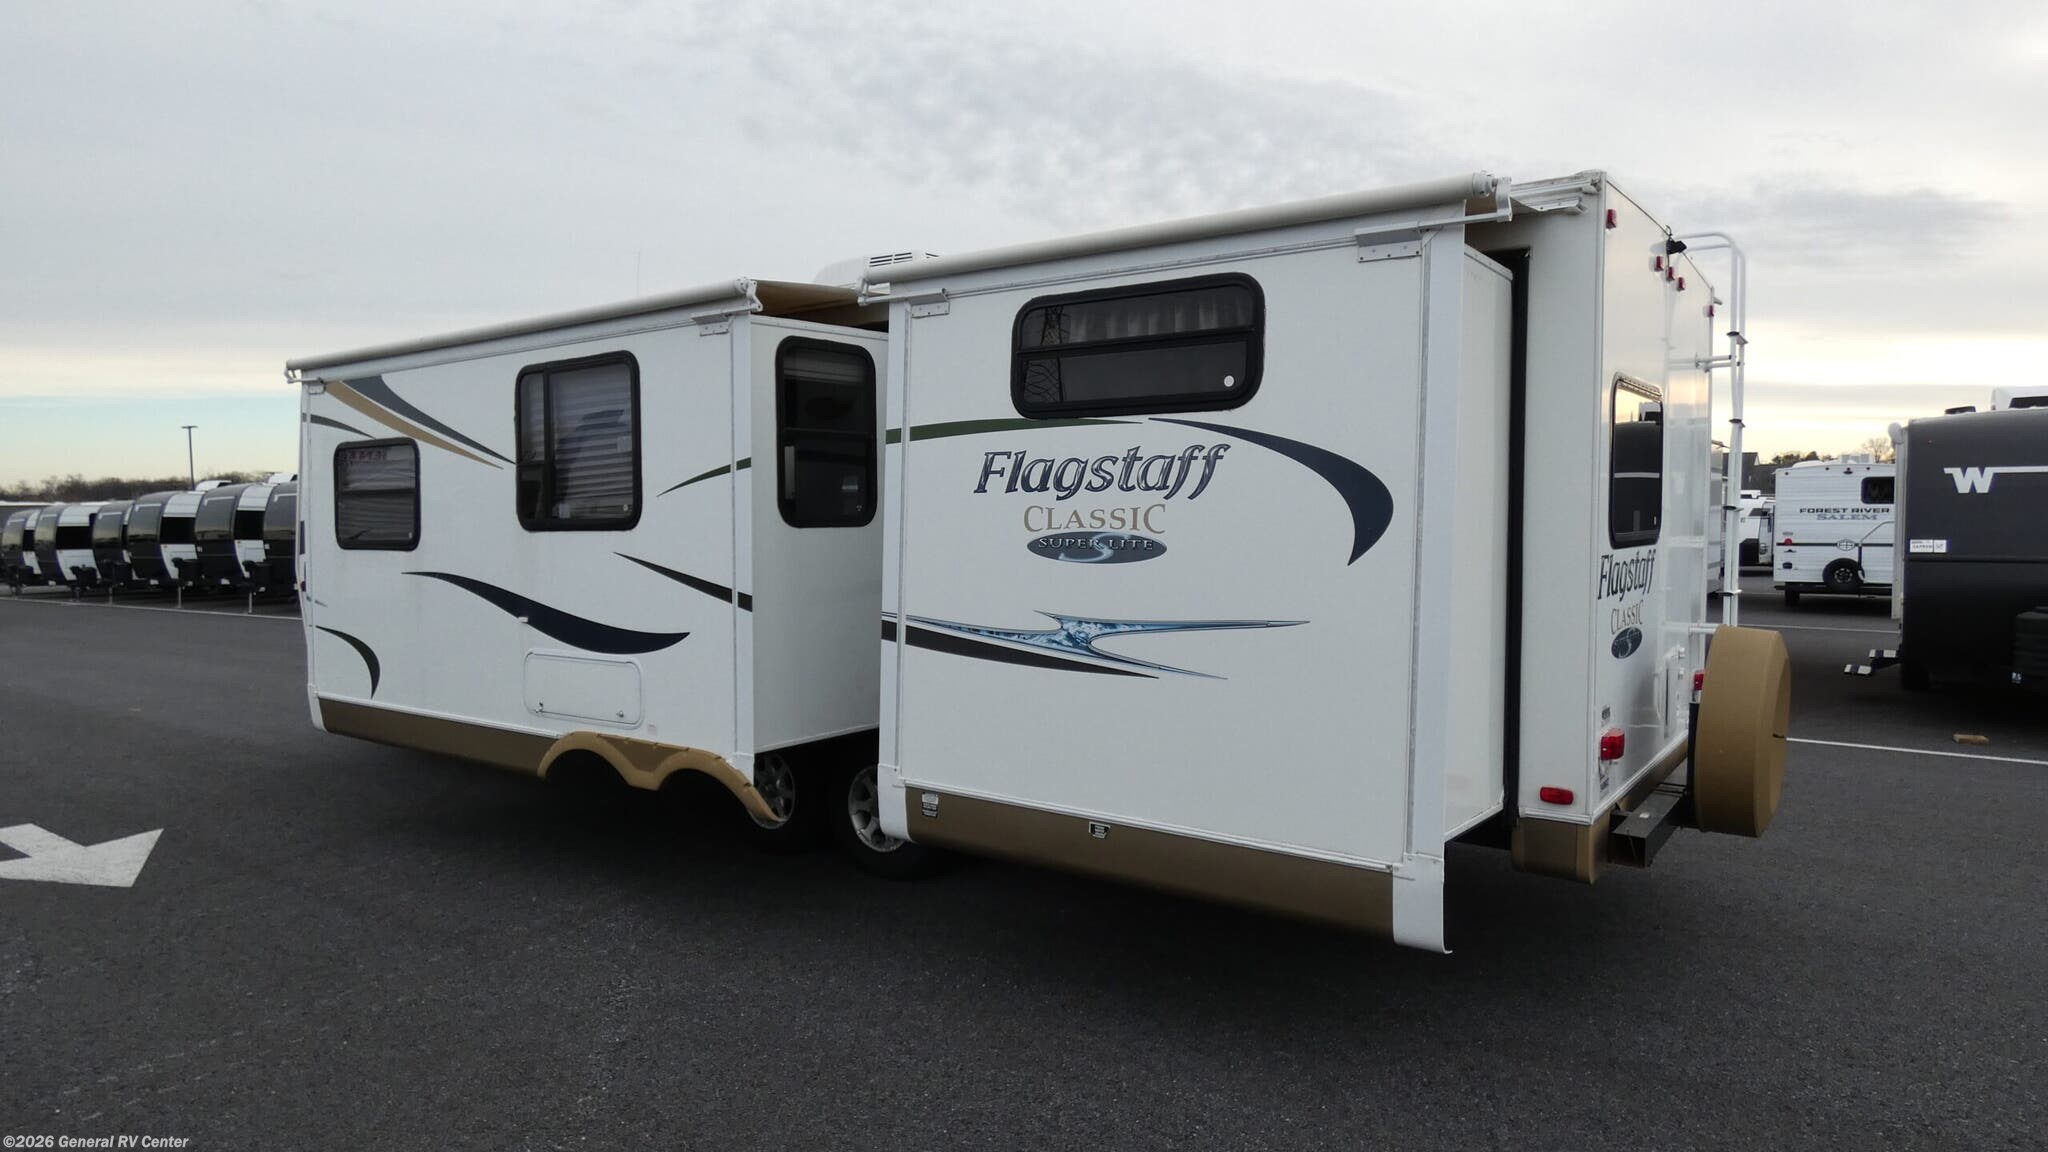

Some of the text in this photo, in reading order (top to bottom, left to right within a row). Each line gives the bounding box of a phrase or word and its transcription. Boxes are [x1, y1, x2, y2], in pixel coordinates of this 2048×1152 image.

[973, 443, 1231, 501] Flagstaff
[1023, 503, 1166, 534] CLASSIC
[1816, 513, 1878, 521] SALEM
[1038, 537, 1153, 550] SUPER LITE
[1597, 548, 1656, 602] Flagstaff
[1611, 599, 1643, 635] CLASSIC
